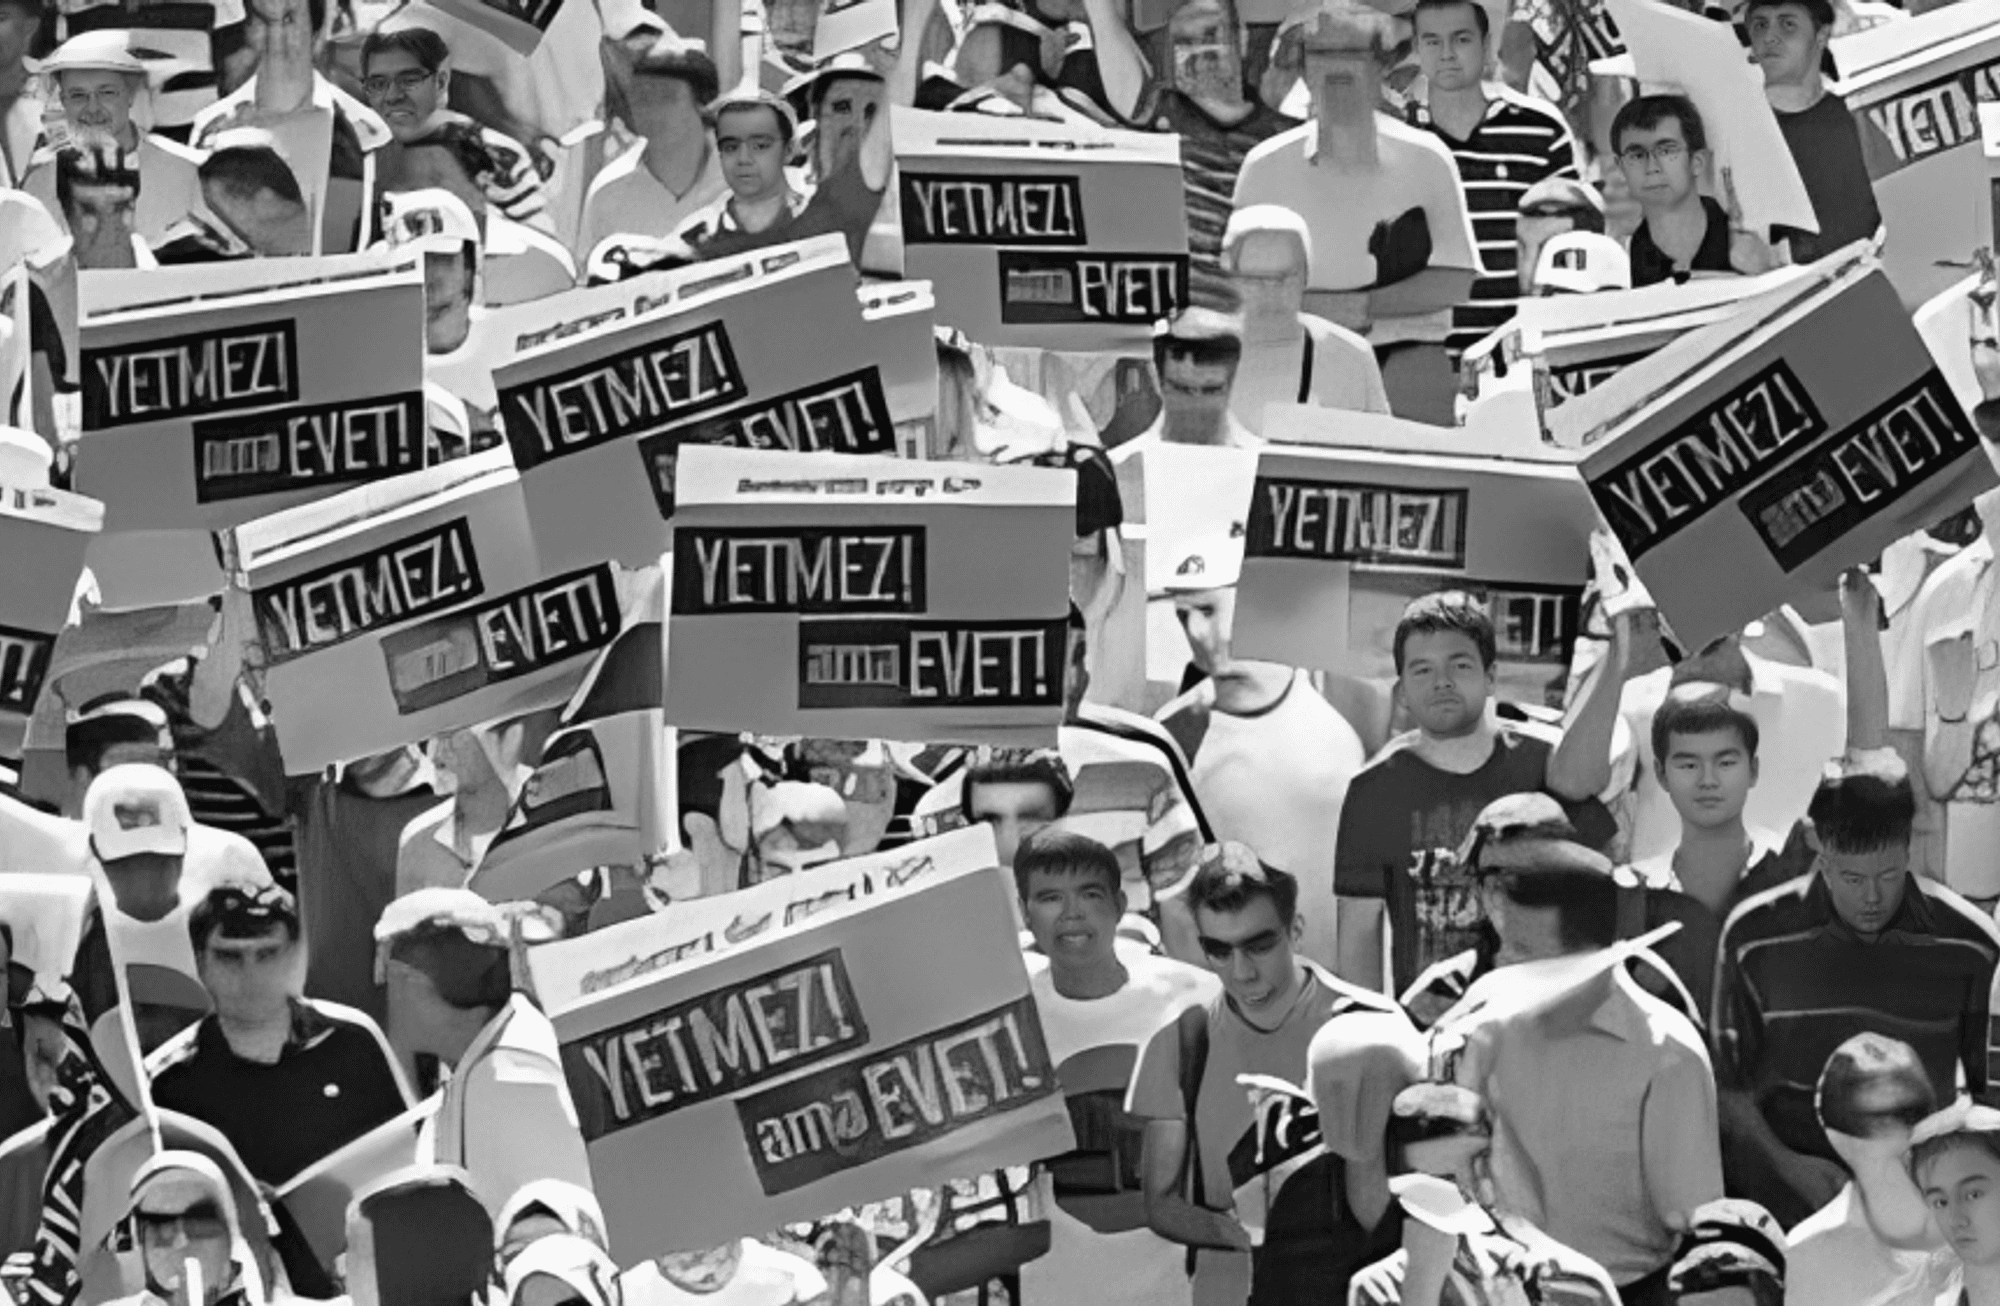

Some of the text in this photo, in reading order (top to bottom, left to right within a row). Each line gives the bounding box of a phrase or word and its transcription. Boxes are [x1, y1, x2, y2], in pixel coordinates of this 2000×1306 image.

[287, 401, 411, 477] EVET!
[517, 330, 733, 453] YETMEZ!
[1830, 386, 1964, 502] EVET!
[1609, 371, 1814, 535] YETMEZ!
[269, 528, 473, 651] YETMEZ!
[477, 572, 609, 671] EVET!
[695, 535, 913, 604] YETMEZ!
[909, 629, 1048, 698] EVET!
[583, 961, 855, 1121] YETMEZ!
[861, 1012, 1043, 1141] EVET!
